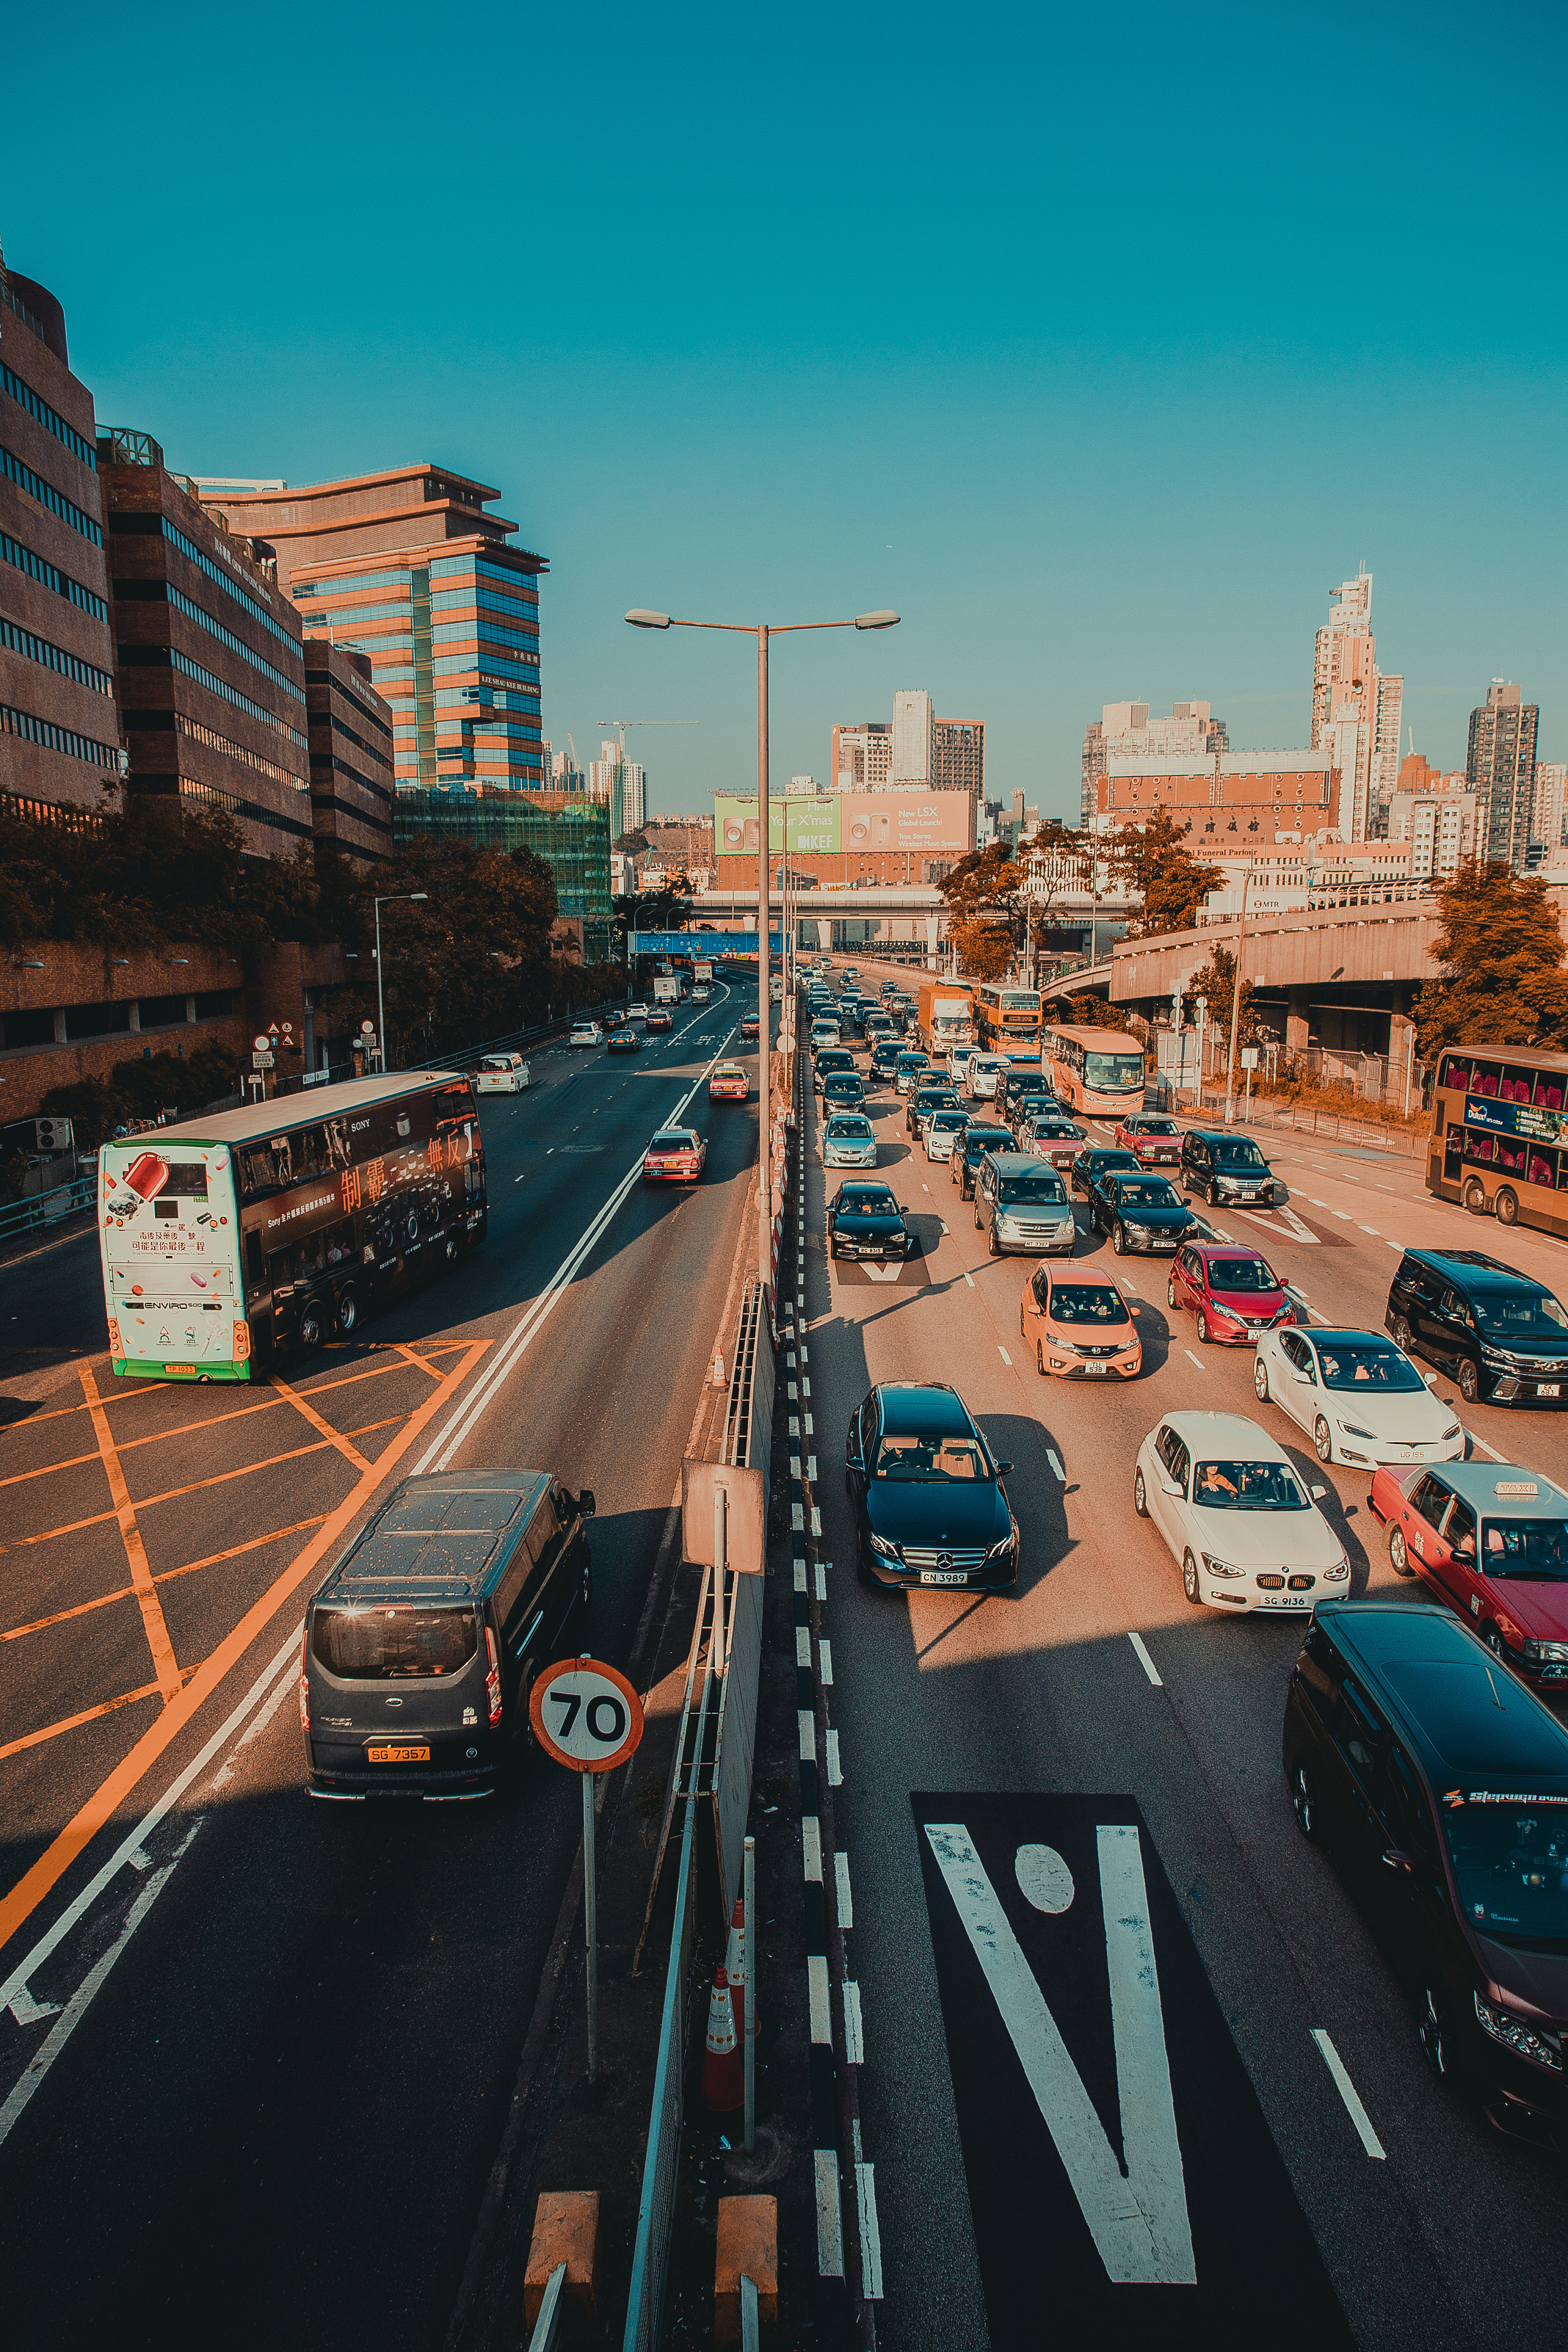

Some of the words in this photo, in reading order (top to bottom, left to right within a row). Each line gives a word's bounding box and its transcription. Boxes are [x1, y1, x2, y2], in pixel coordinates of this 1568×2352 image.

[513, 651, 538, 664] 李兆基樓
[492, 678, 505, 687] SHAU
[517, 684, 539, 694] BUILDING
[917, 807, 937, 817] LSX
[798, 814, 833, 825] X'mas
[811, 835, 833, 848] KEF
[1468, 1110, 1486, 1121] Dulux
[351, 1119, 371, 1132] SONY
[268, 1217, 281, 1228] Sony
[132, 1241, 205, 1251] 可能是你最後一程
[1415, 1530, 1425, 1543] 的士
[1414, 1539, 1424, 1556] TAXI
[550, 1692, 626, 1742] 70
[372, 1751, 389, 1760] SG
[394, 1749, 426, 1759] 7357
